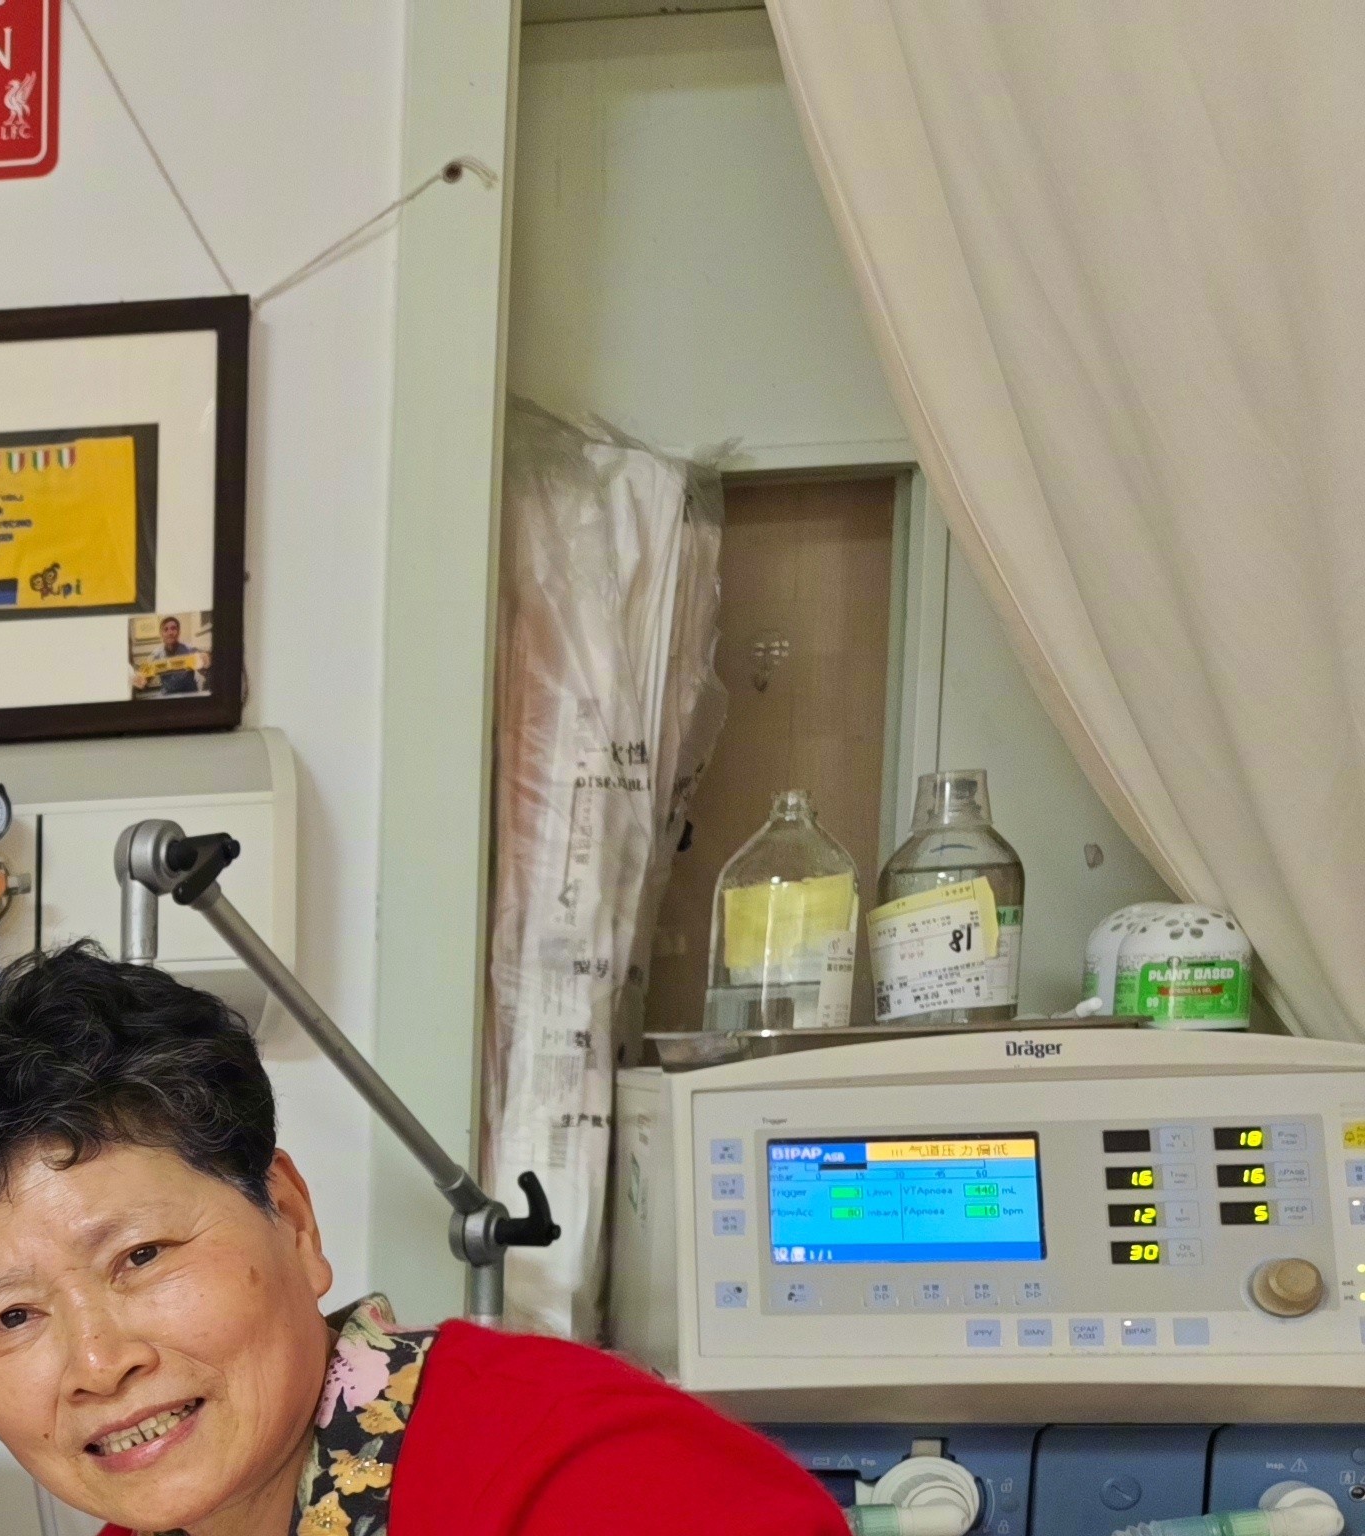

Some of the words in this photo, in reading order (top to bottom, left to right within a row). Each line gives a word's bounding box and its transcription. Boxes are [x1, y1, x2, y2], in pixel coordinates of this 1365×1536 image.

[1148, 968, 1191, 982] PLANT
[1193, 967, 1235, 980] BASED
[1005, 1039, 1063, 1060] Dräger
[772, 1147, 822, 1161] BIPAP
[823, 1153, 846, 1162] ASB
[909, 1144, 1009, 1157] 气道压力偏低
[1242, 1168, 1266, 1184] 16
[1001, 1186, 1017, 1195] mL
[1133, 1208, 1157, 1224] 12
[1129, 1244, 1159, 1261] 30
